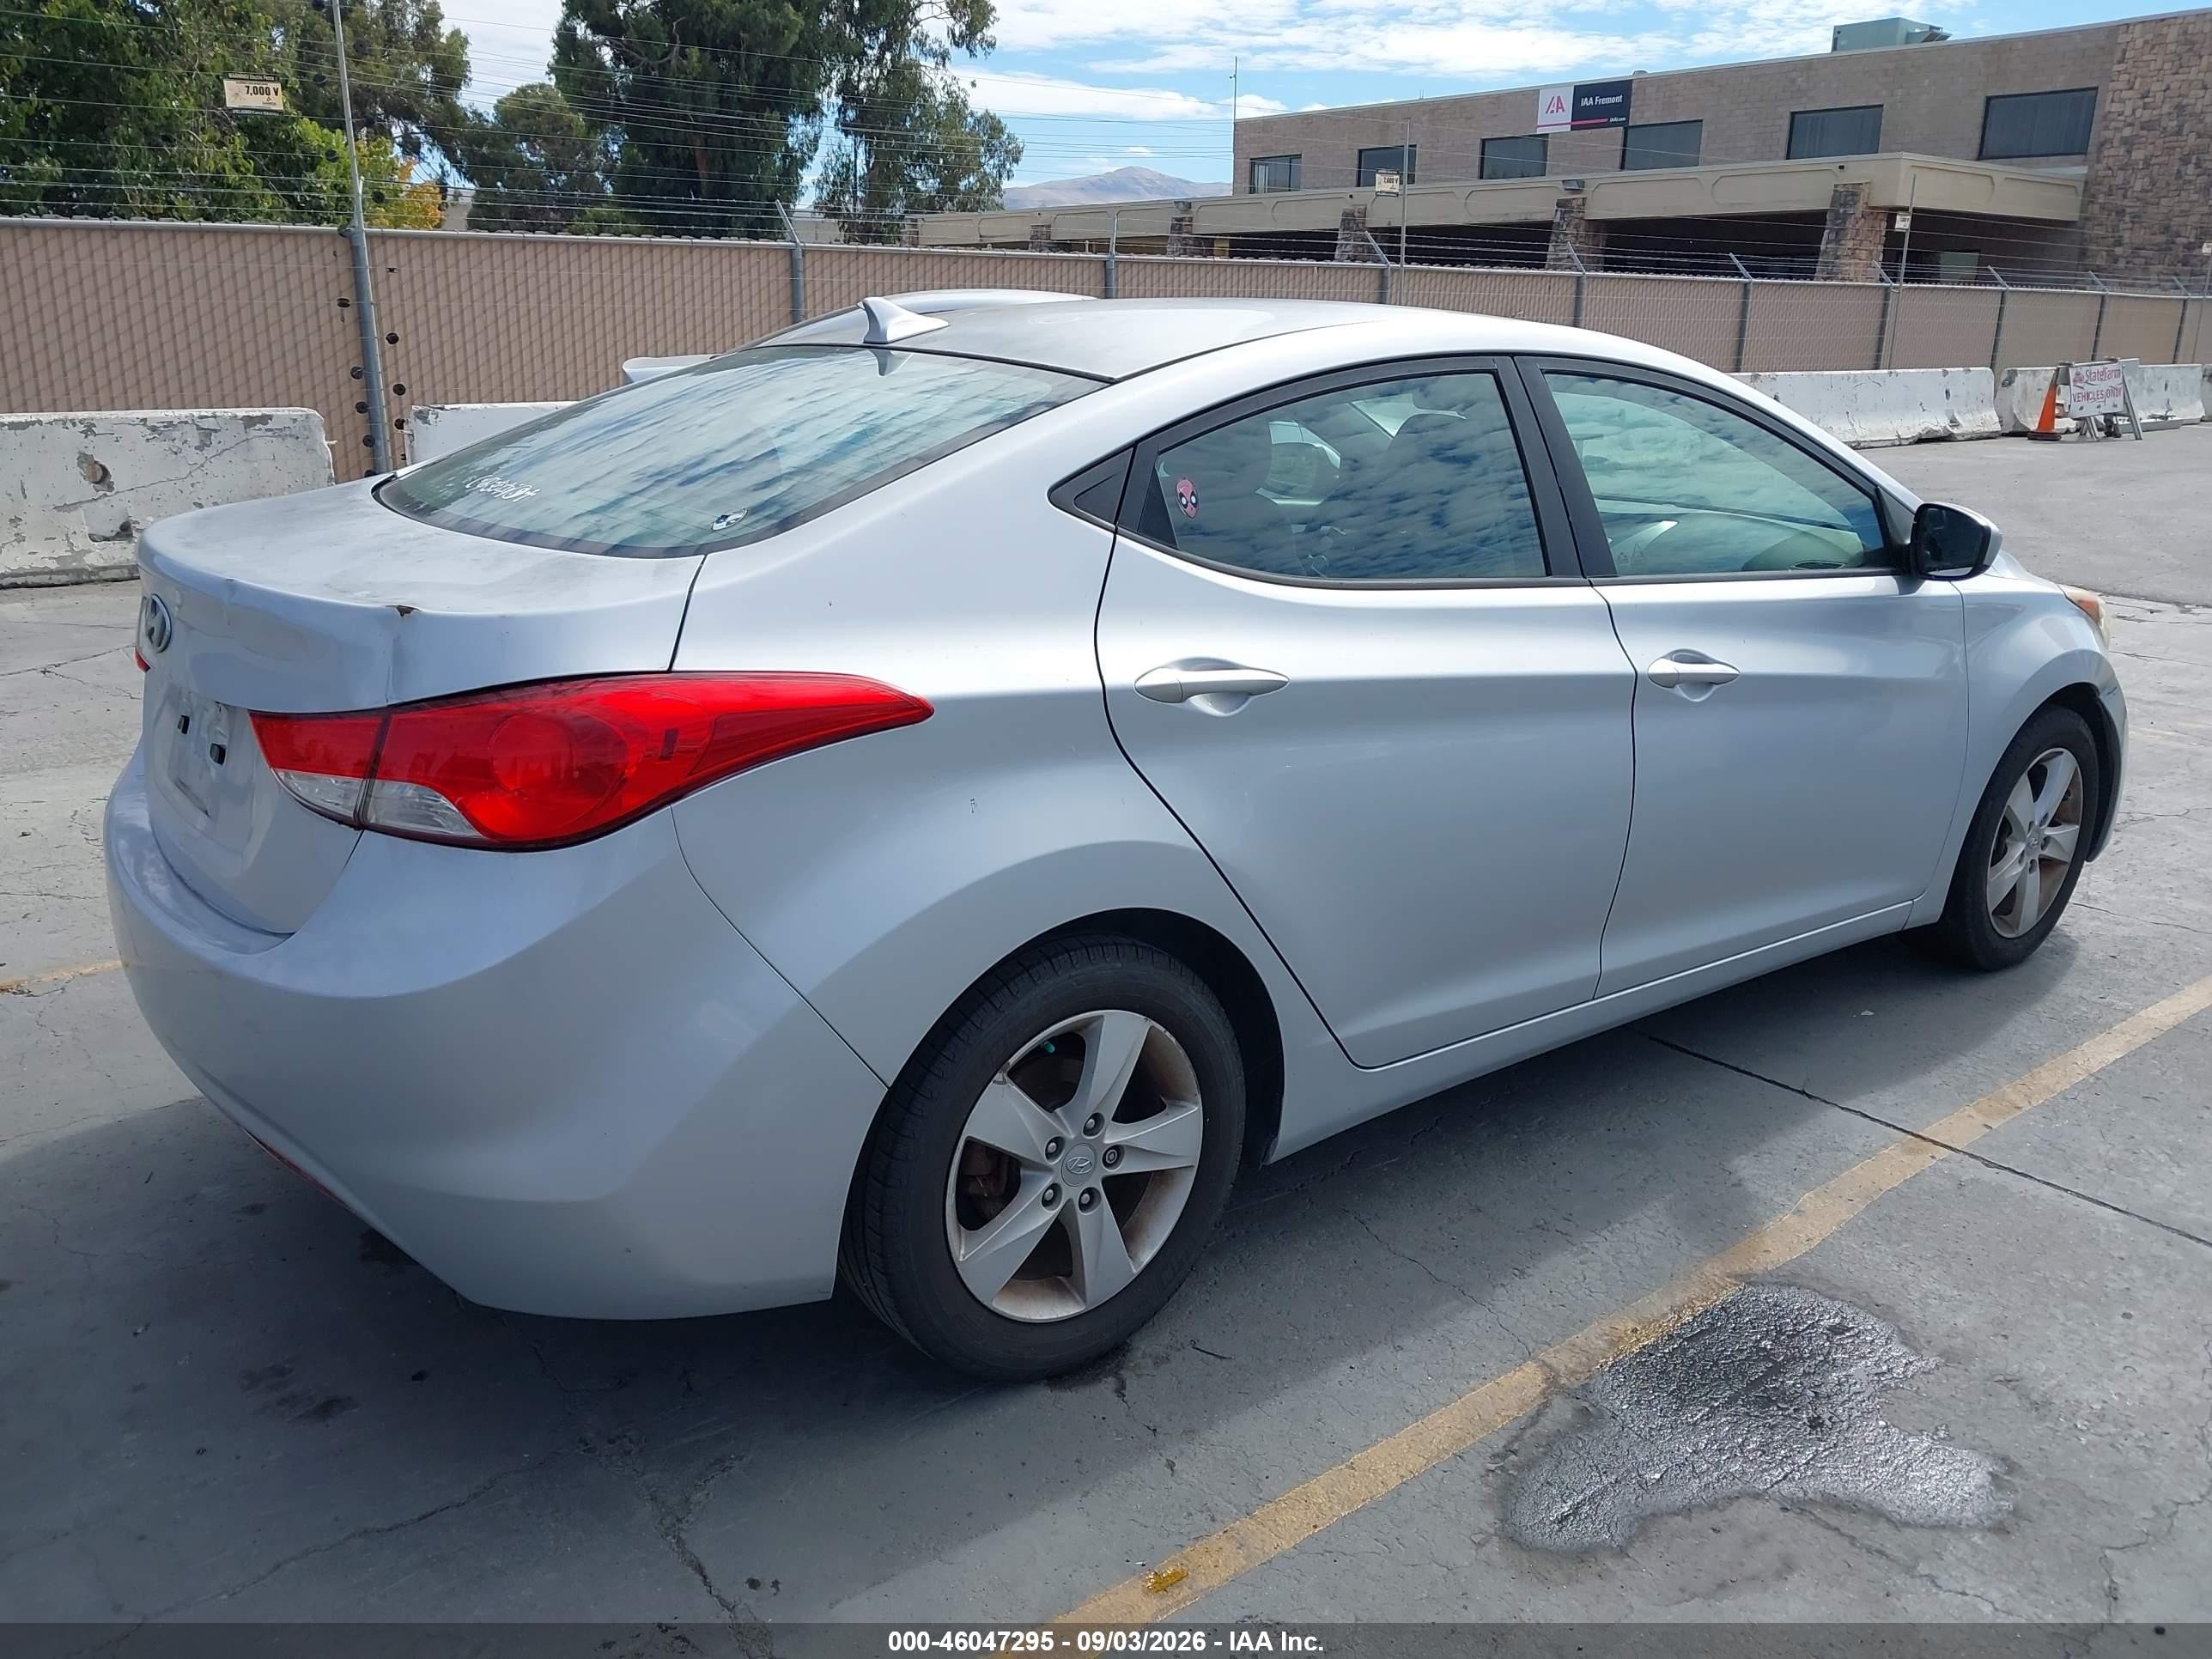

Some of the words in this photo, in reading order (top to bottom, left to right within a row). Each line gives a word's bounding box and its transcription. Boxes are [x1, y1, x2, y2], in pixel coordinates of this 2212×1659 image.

[245, 85, 271, 97] 7,000
[273, 87, 279, 97] V
[1581, 96, 1594, 107] IAA
[1595, 94, 1623, 106] Fremont
[2072, 390, 2104, 403] VEHICLES
[2106, 386, 2123, 398] ONLY
